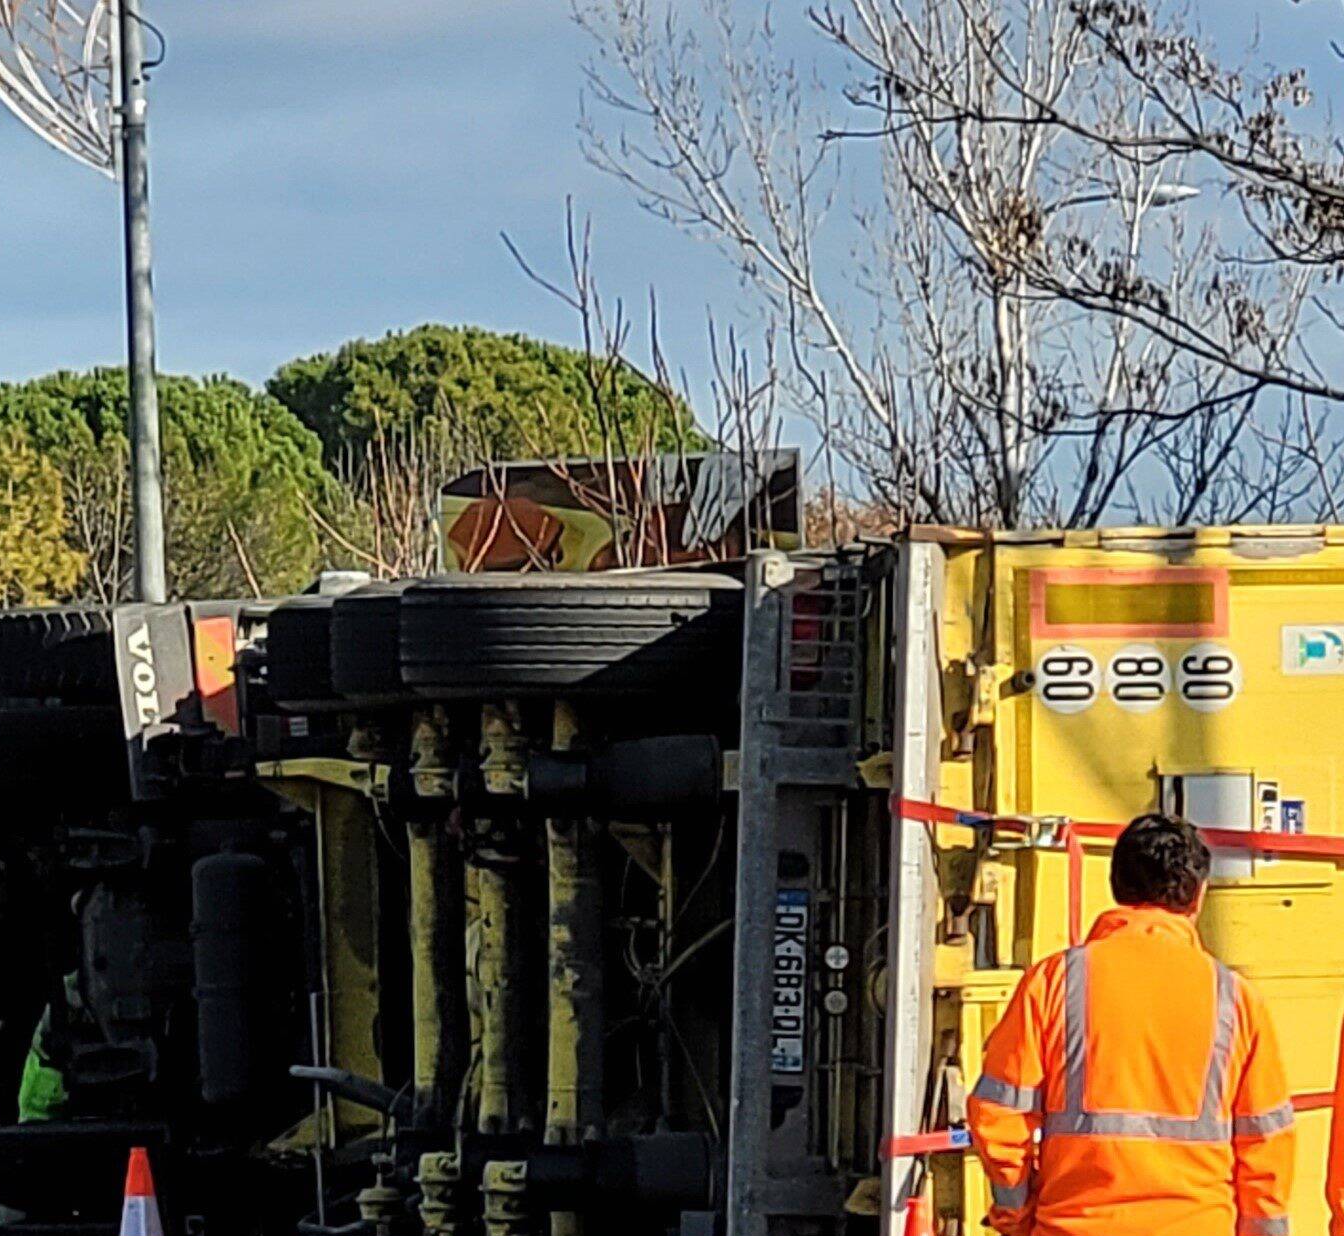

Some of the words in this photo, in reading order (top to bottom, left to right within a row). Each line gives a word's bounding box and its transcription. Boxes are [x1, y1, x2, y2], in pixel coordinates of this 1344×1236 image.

[127, 621, 161, 725] VOL
[1042, 656, 1095, 701] 60
[1112, 657, 1165, 701] 80
[1182, 655, 1234, 700] 90
